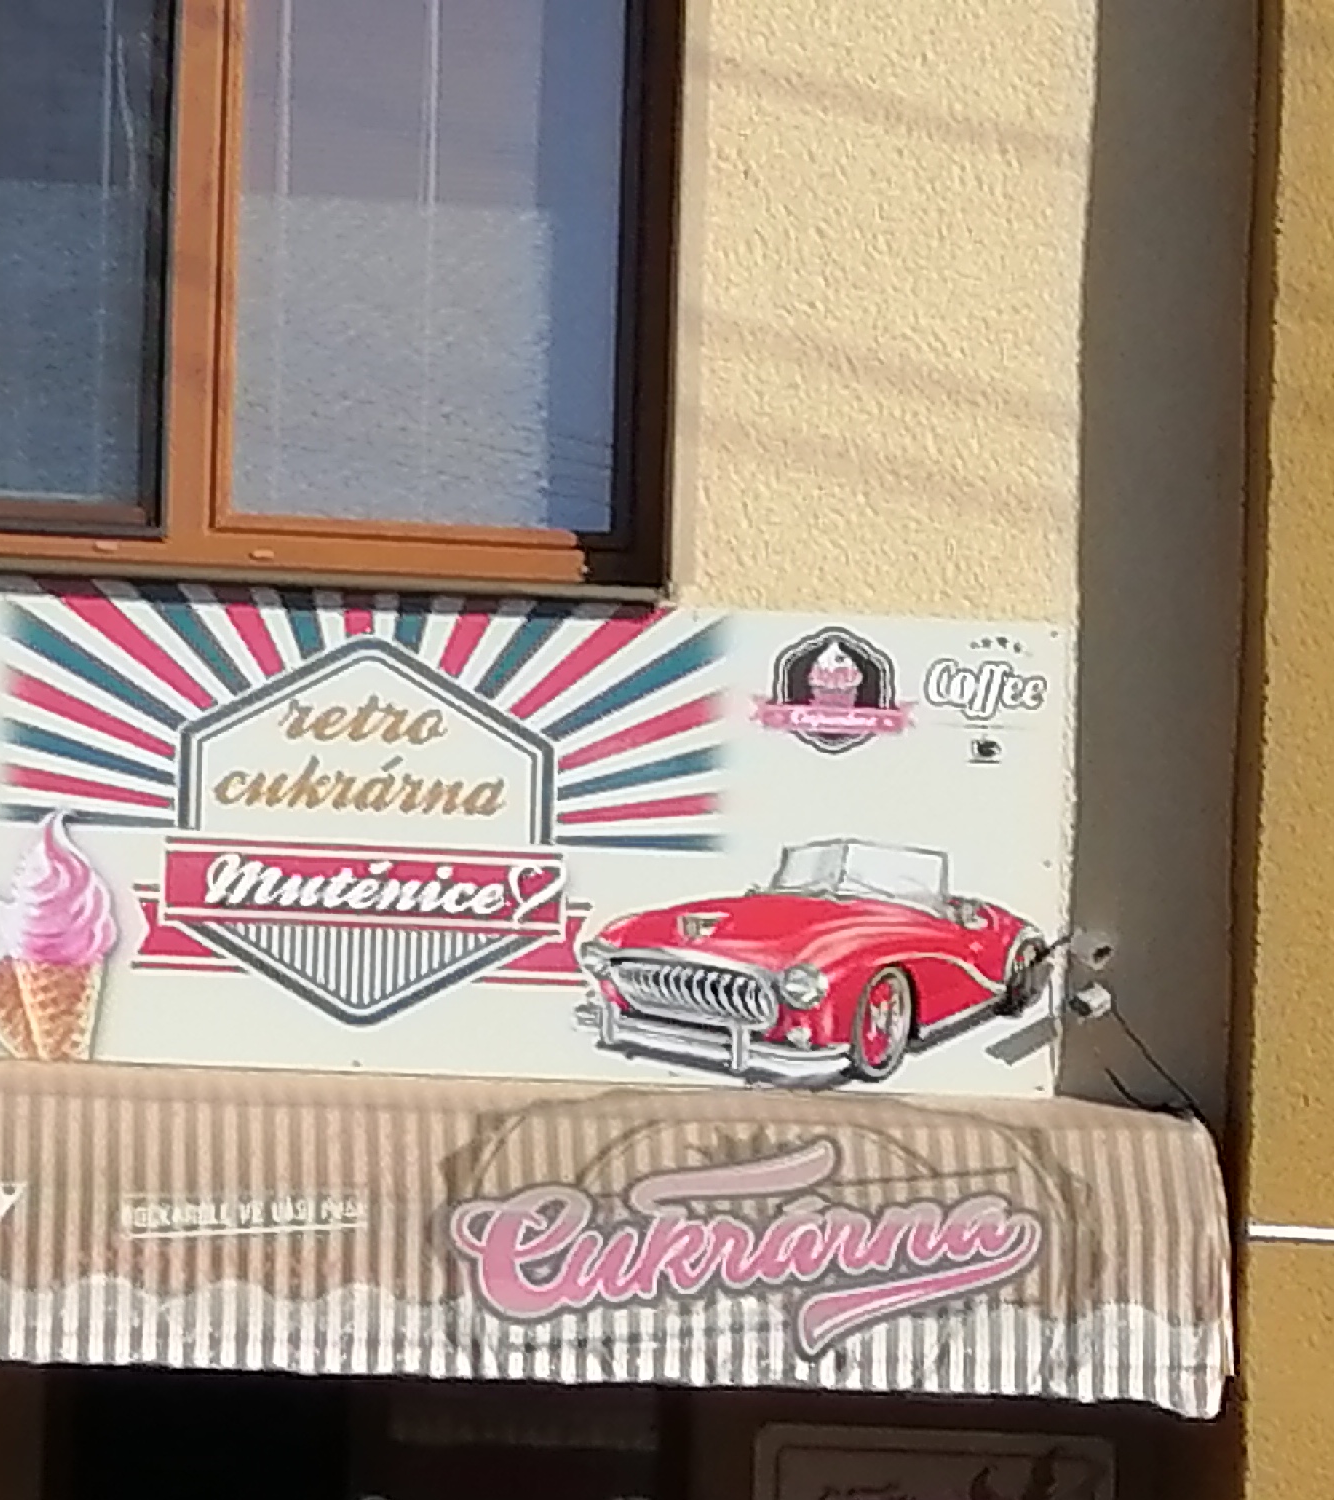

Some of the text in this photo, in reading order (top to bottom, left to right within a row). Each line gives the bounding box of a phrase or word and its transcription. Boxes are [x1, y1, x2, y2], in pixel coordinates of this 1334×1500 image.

[925, 658, 1047, 718] Coffee
[277, 695, 448, 747] retro
[213, 755, 506, 817] cukrárna
